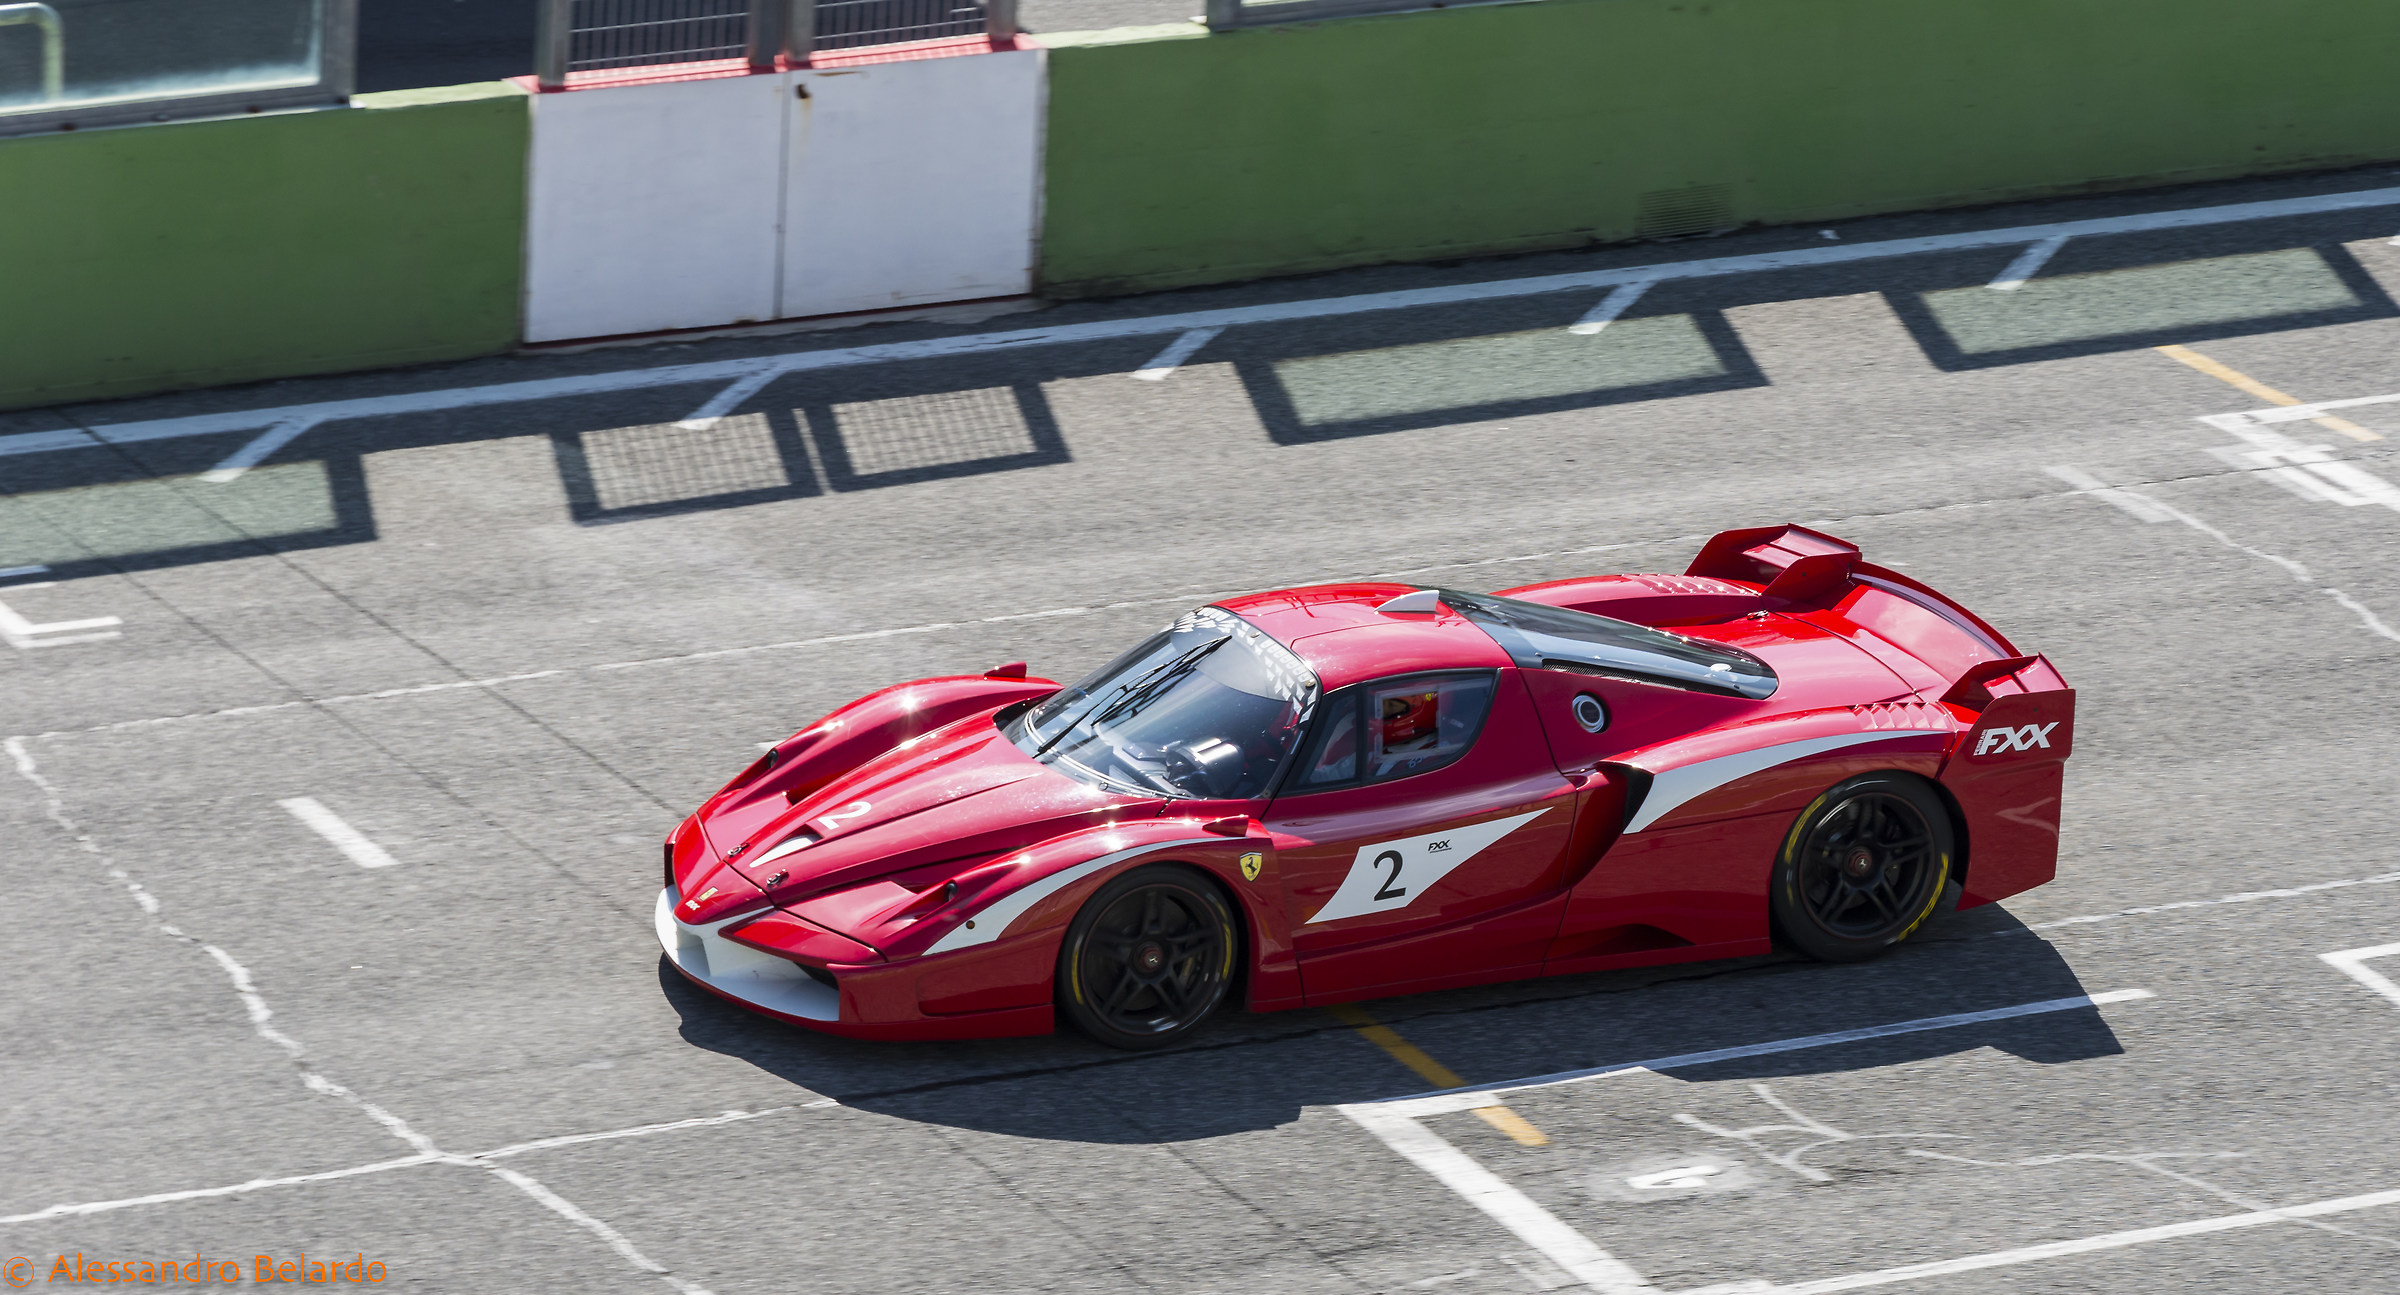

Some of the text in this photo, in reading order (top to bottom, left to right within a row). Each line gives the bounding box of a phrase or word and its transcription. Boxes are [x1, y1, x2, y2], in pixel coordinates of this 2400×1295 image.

[1979, 721, 2060, 755] FXX
[816, 801, 872, 830] 2
[1428, 839, 1451, 851] FXX
[1373, 849, 1407, 902] 2
